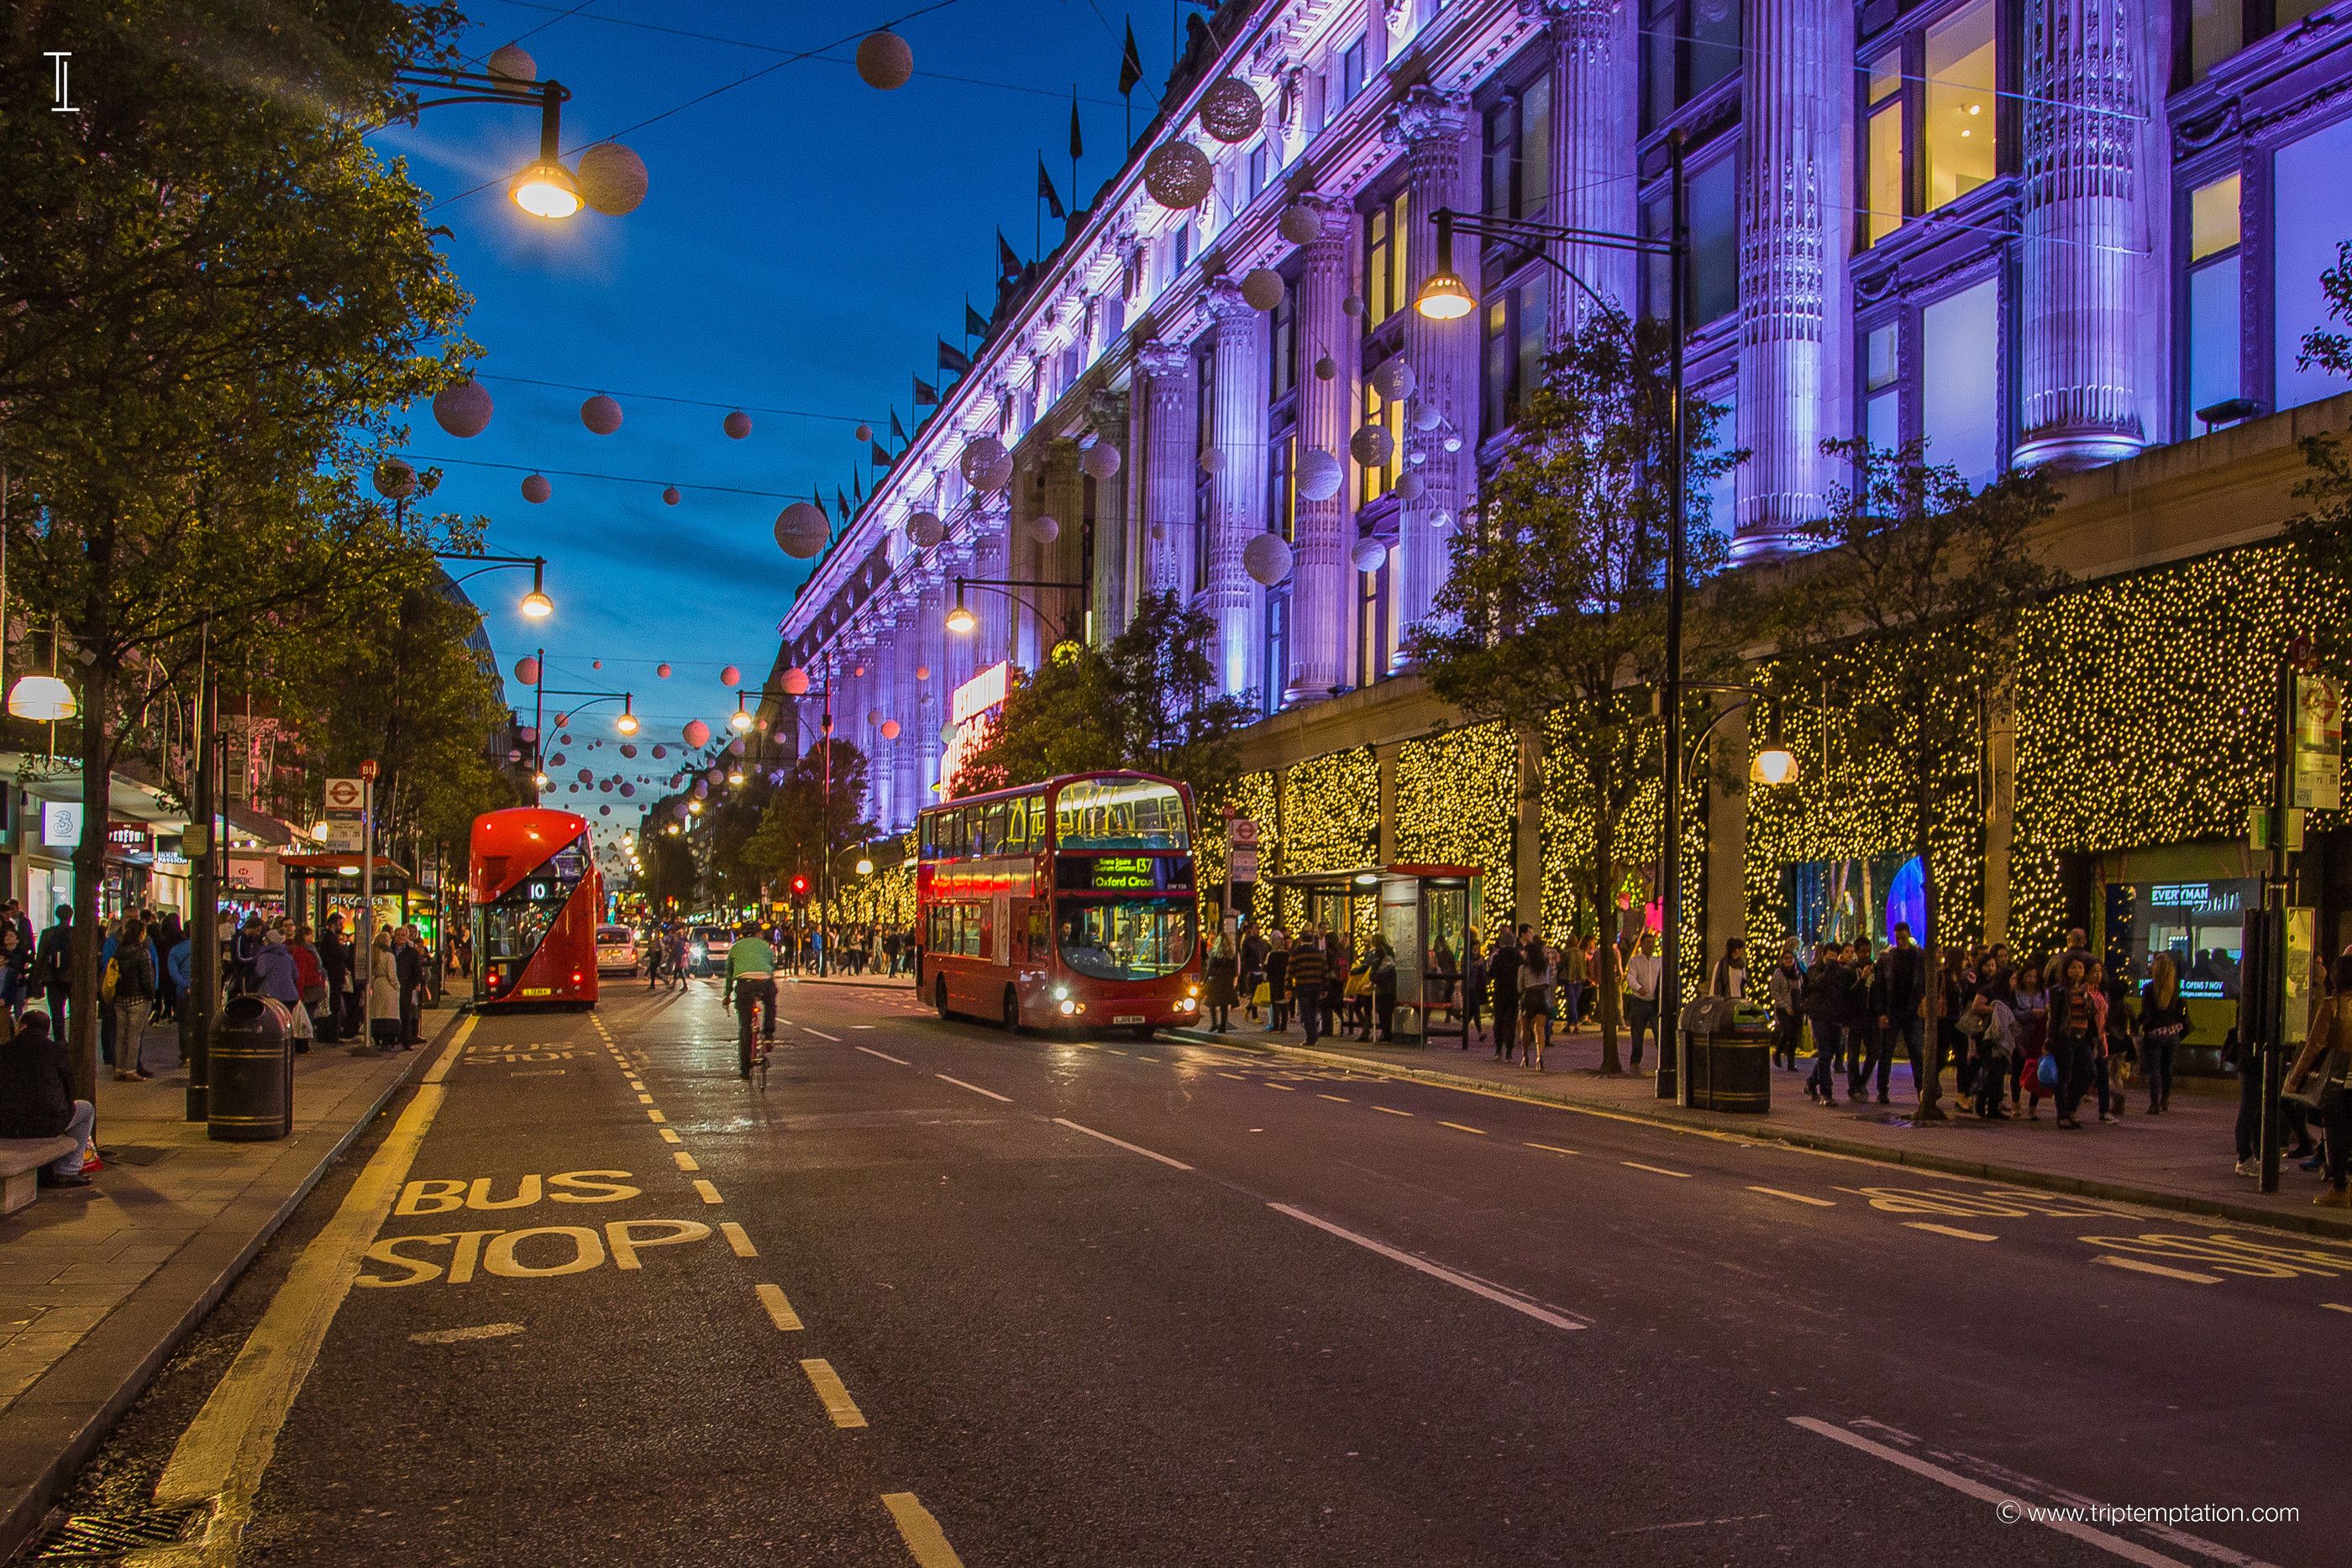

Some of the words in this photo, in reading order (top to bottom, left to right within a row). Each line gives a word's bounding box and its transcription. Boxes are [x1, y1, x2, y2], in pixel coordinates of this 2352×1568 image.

[53, 810, 73, 835] 3
[1137, 857, 1152, 873] 137
[1095, 876, 1126, 887] Oxford
[1128, 876, 1154, 887] Circus
[531, 884, 545, 899] 10
[2151, 888, 2209, 901] EVERYMAN
[2186, 981, 2204, 989] OPENS
[2209, 981, 2224, 989] NOV
[394, 1170, 642, 1216] BUS
[354, 1219, 712, 1288] STOP
